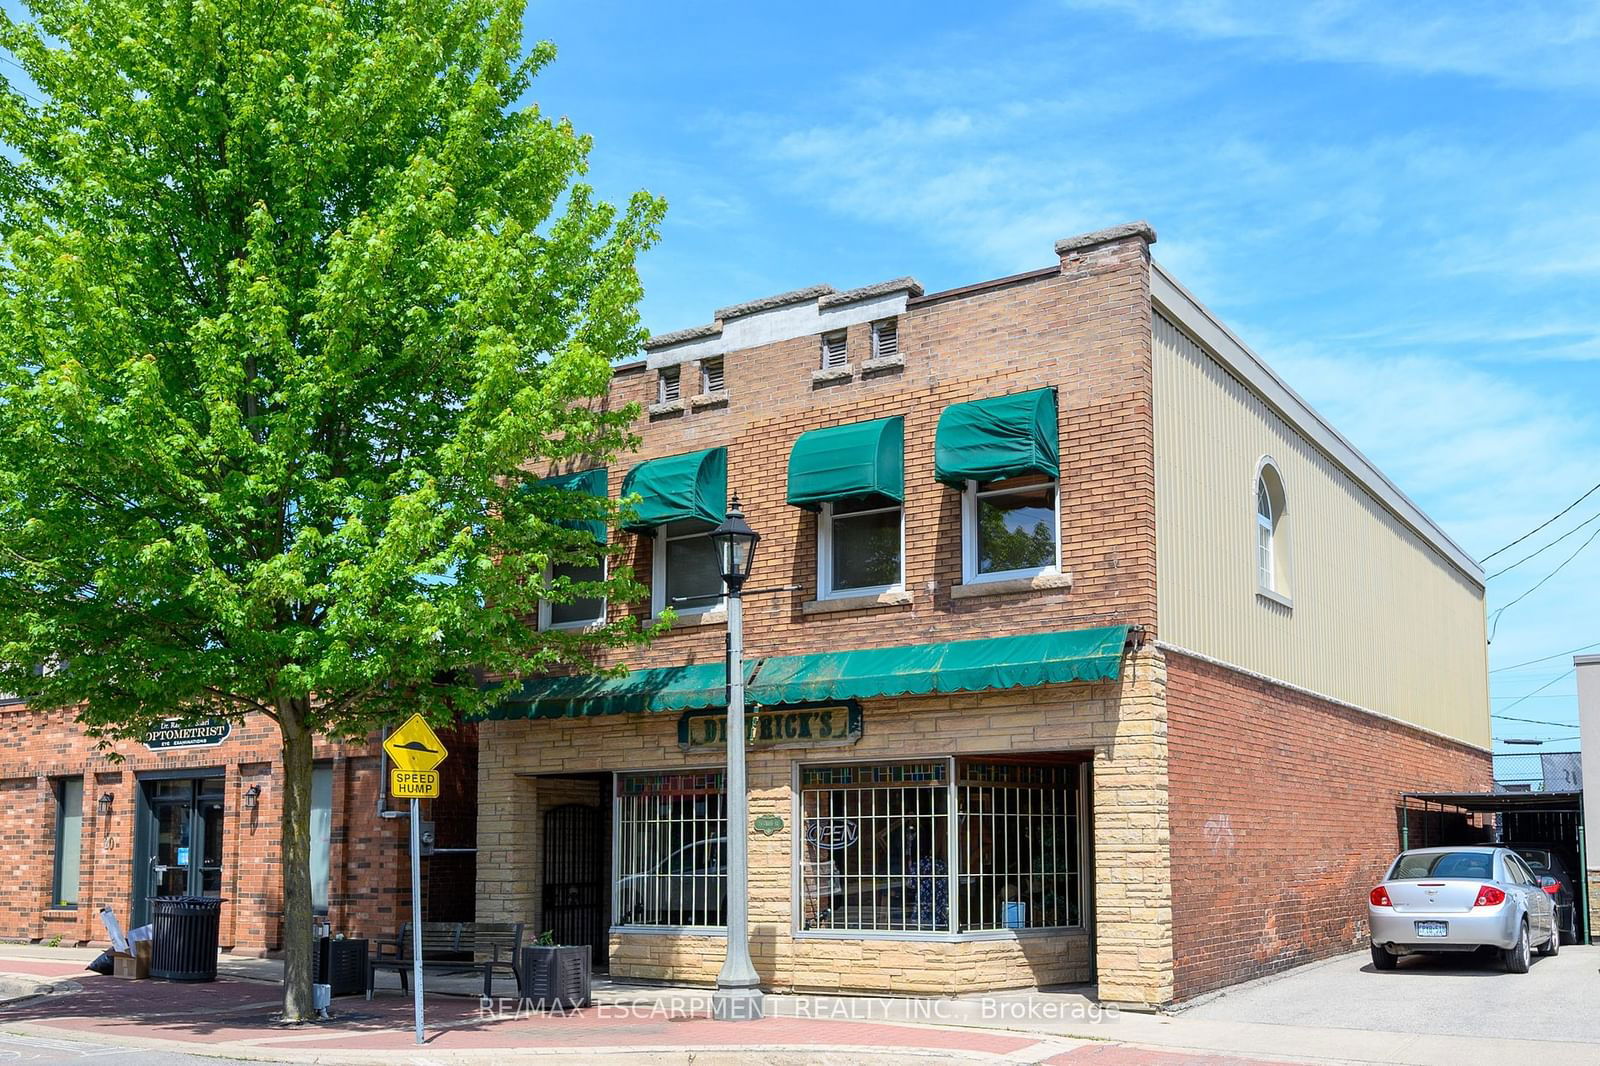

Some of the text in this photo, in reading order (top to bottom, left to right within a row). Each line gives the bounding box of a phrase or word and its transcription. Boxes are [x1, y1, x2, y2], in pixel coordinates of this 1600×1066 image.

[145, 726, 225, 742] OPTOMETRIST
[173, 738, 208, 746] EXAMINATIONS
[396, 773, 435, 784] SPEED
[398, 783, 433, 794] HUMP
[808, 824, 858, 841] OPEN
